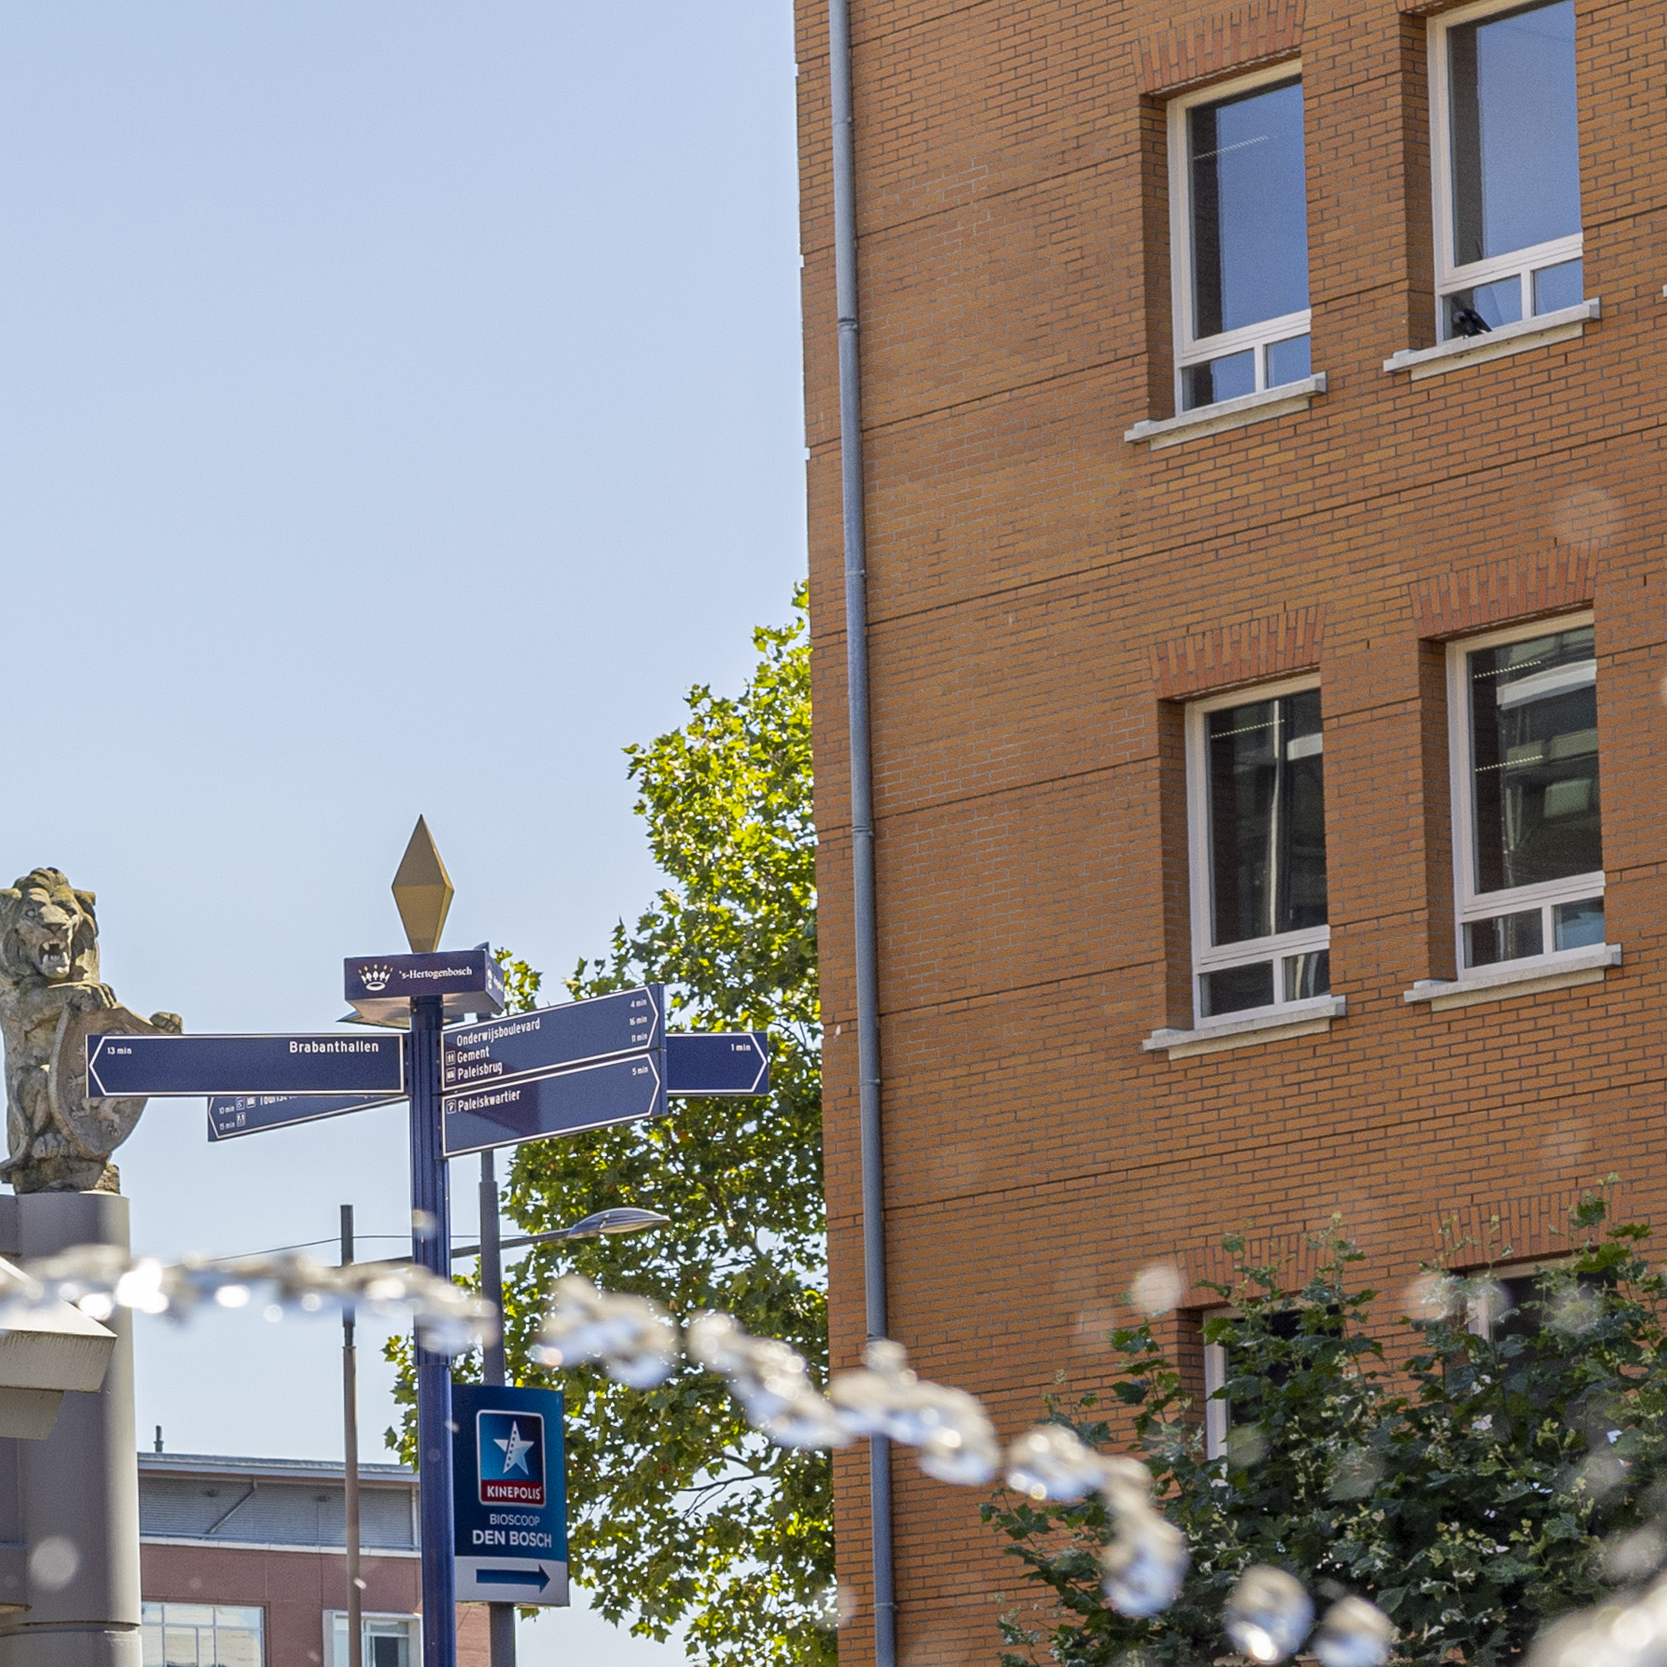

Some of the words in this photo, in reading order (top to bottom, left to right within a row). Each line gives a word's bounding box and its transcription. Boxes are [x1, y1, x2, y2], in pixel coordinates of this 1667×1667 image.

[399, 967, 472, 979] 's-Hertogenbosch
[636, 999, 647, 1007] min
[636, 1016, 647, 1024] min
[457, 1017, 541, 1046] Onderwijsboulevard
[637, 1033, 647, 1041] min
[107, 1047, 115, 1055] 13
[289, 1041, 379, 1053] Brabanthallen
[736, 1043, 751, 1051] min
[457, 1046, 490, 1063] Gement
[457, 1062, 503, 1080] Paleisbrug
[637, 1066, 648, 1075] min
[458, 1090, 521, 1112] Paleiskwartier
[486, 1485, 541, 1500] KINEPOLIS
[490, 1513, 541, 1526] BIOSCOOP
[472, 1530, 506, 1546] DEN
[509, 1532, 552, 1548] BOSCH
